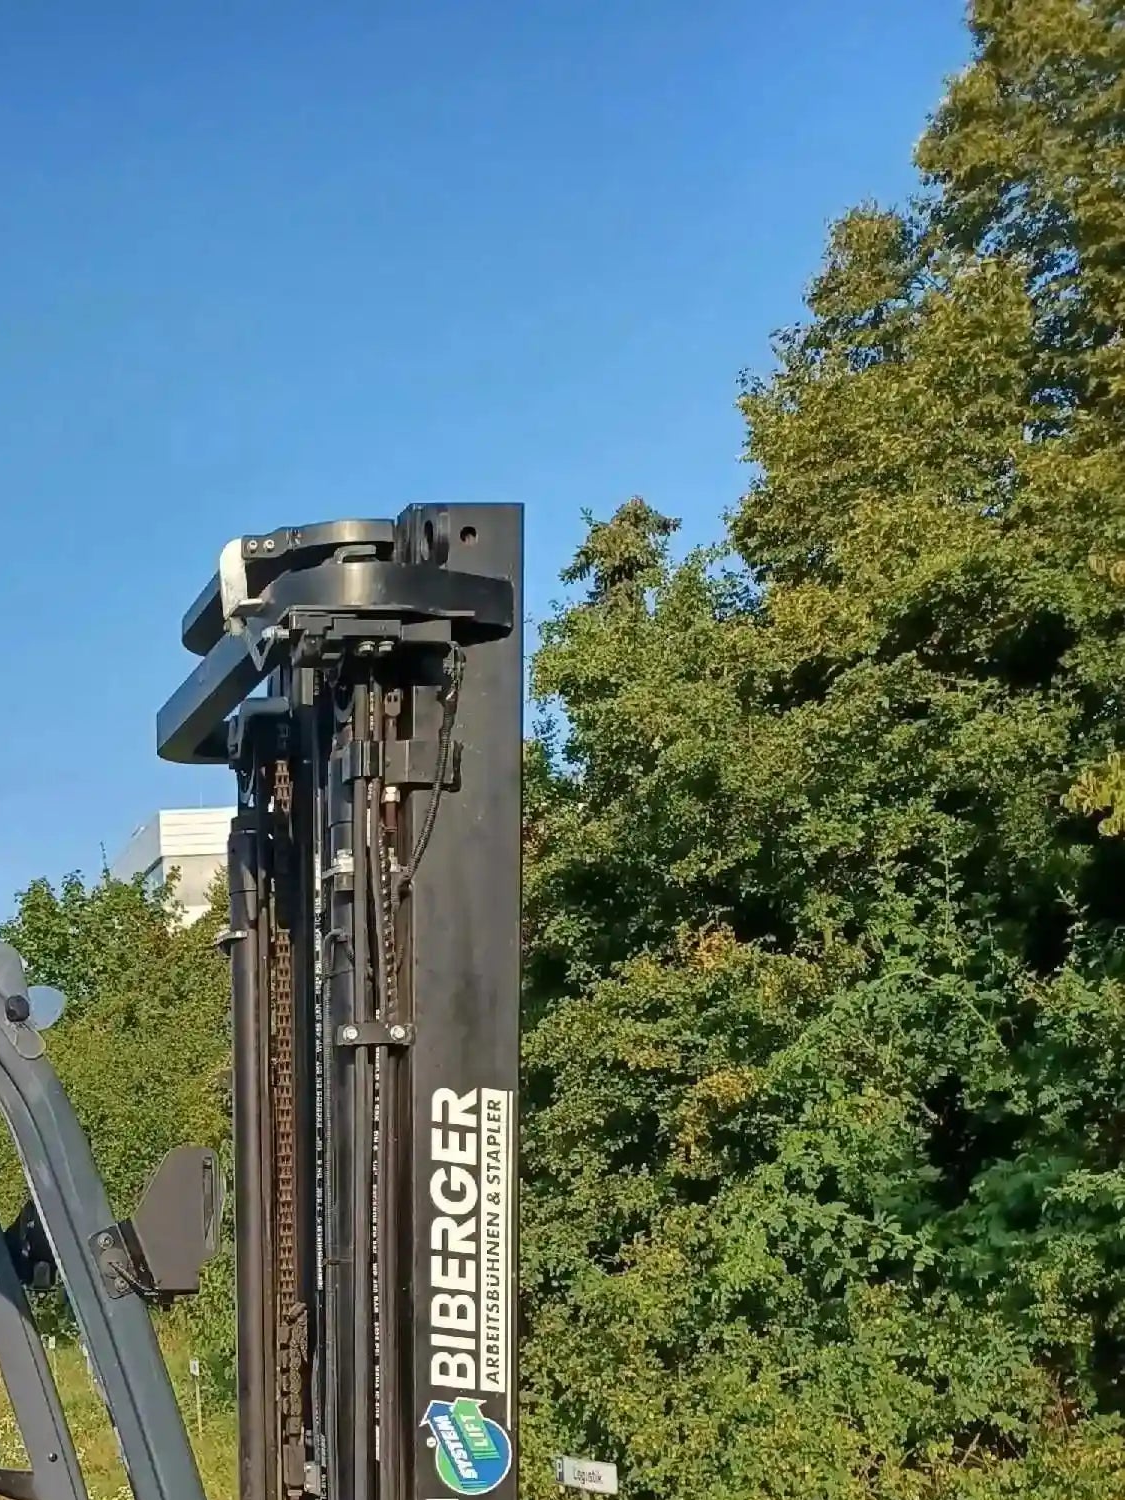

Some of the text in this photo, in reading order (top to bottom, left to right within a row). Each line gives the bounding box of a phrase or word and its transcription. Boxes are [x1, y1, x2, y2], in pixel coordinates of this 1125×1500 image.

[430, 1087, 477, 1390] BIBERGER
[485, 1099, 502, 1385] ARBEITSBÜHNEN & STAPLER
[433, 1415, 478, 1480] SYSTEM
[460, 1413, 489, 1447] LIFT
